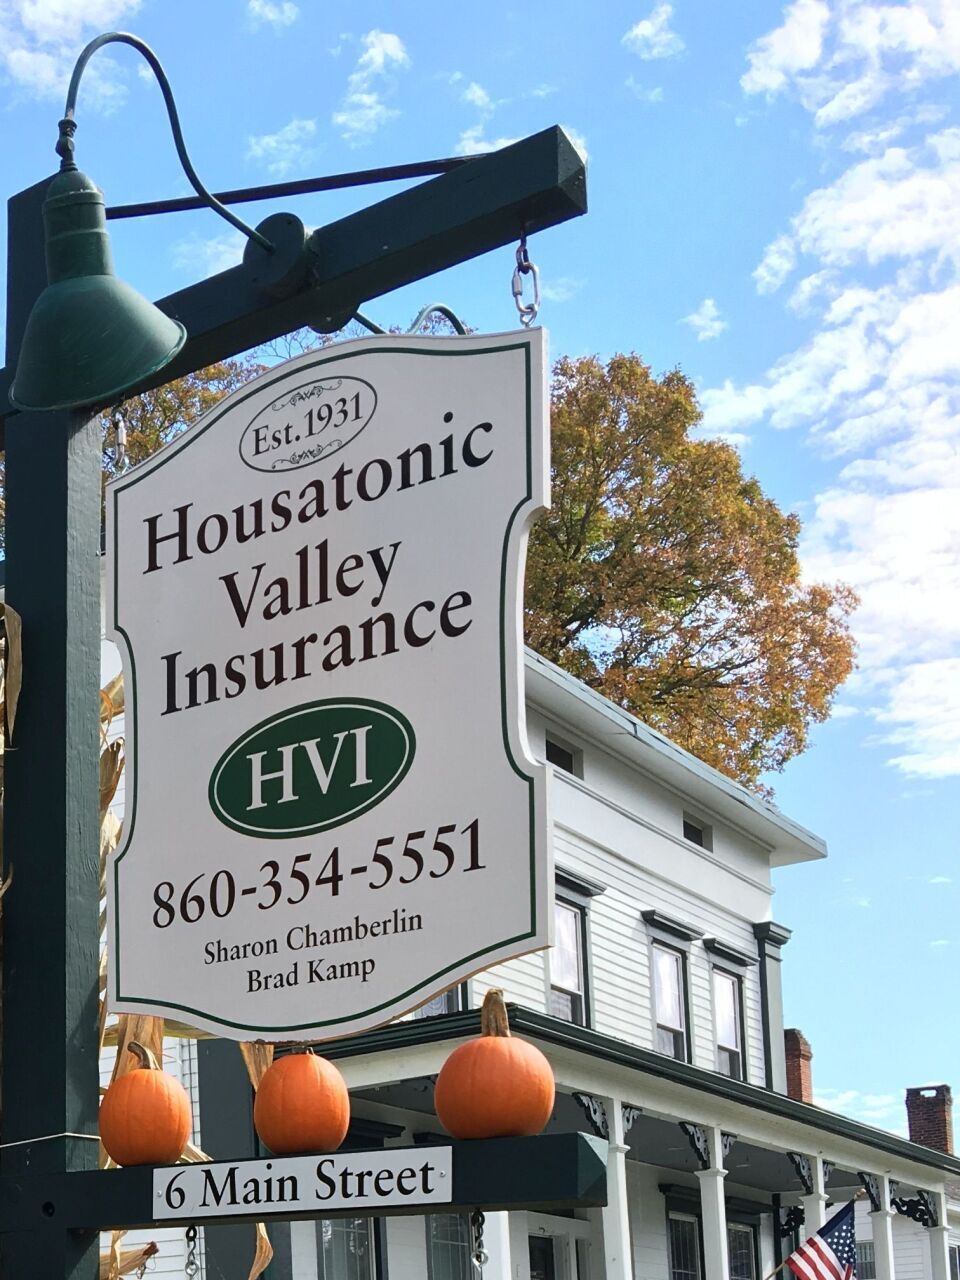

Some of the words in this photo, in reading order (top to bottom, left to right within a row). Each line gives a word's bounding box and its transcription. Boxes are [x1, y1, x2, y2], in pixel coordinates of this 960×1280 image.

[142, 411, 494, 575] Housatonic
[219, 540, 403, 629] Valley
[160, 590, 473, 717] Insurance
[246, 725, 373, 811] HVI
[152, 818, 487, 929] 860-354-5551
[204, 938, 279, 965] Sharon
[286, 908, 424, 951] Chamberlin
[247, 969, 299, 993] Brad
[307, 958, 376, 984] Kamp
[165, 1170, 186, 1210] 6
[198, 1162, 300, 1208] Main
[315, 1158, 435, 1201] Street
